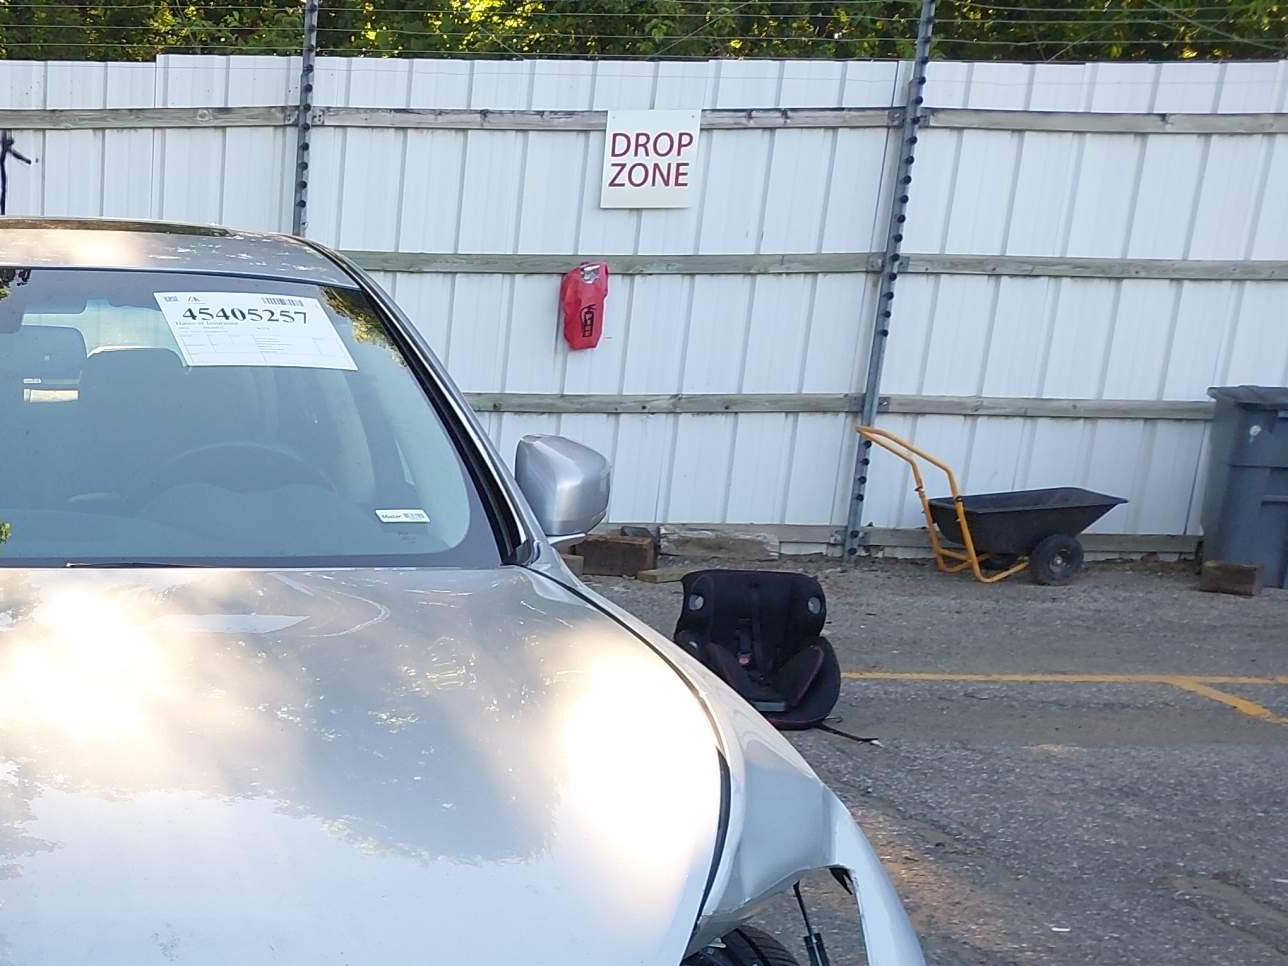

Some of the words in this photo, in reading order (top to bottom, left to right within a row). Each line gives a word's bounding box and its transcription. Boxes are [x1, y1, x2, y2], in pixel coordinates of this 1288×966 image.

[610, 132, 694, 157] DROP
[608, 162, 690, 187] ZONE
[182, 307, 307, 324] 45405257
